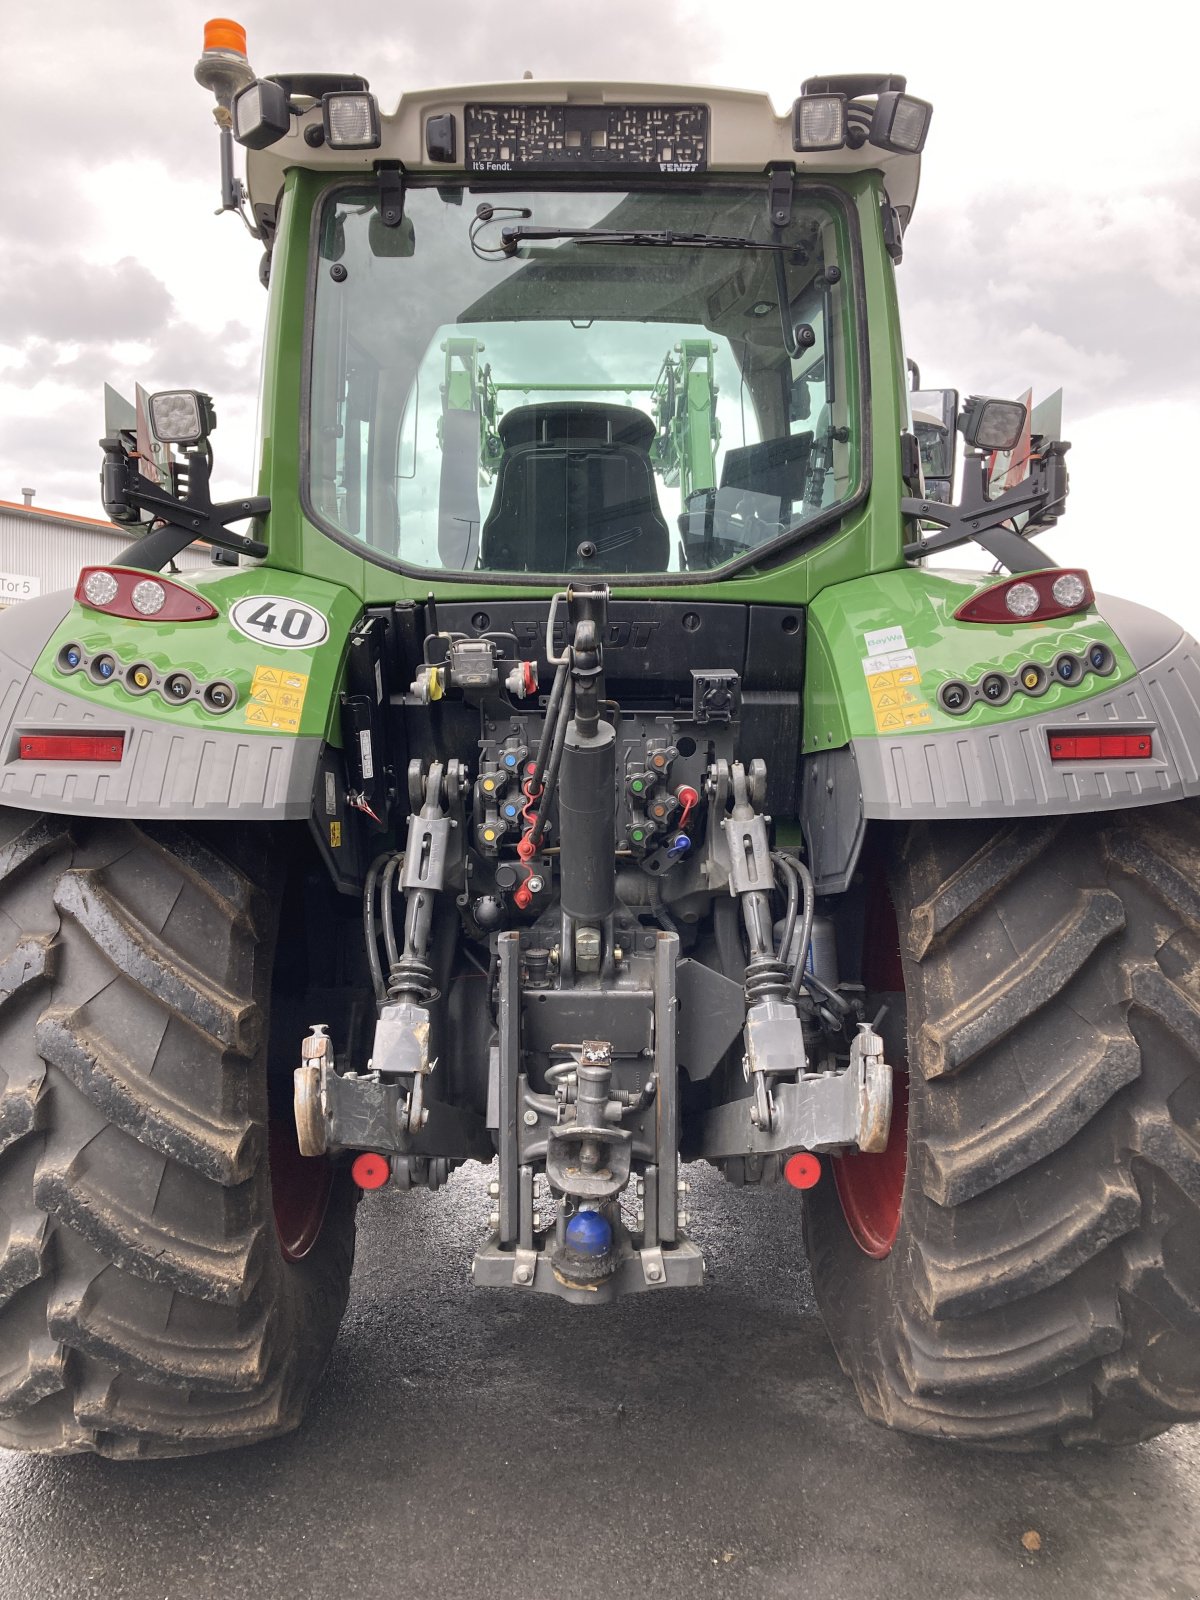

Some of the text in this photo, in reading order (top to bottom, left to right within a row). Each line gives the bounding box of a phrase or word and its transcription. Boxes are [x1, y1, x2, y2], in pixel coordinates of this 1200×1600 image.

[473, 161, 512, 171] It's Fendt.
[660, 163, 699, 172] FENDT
[0, 577, 31, 594] Tor 5
[246, 601, 313, 640] 40
[512, 621, 661, 649] FEDT
[867, 634, 903, 647] BayWa
